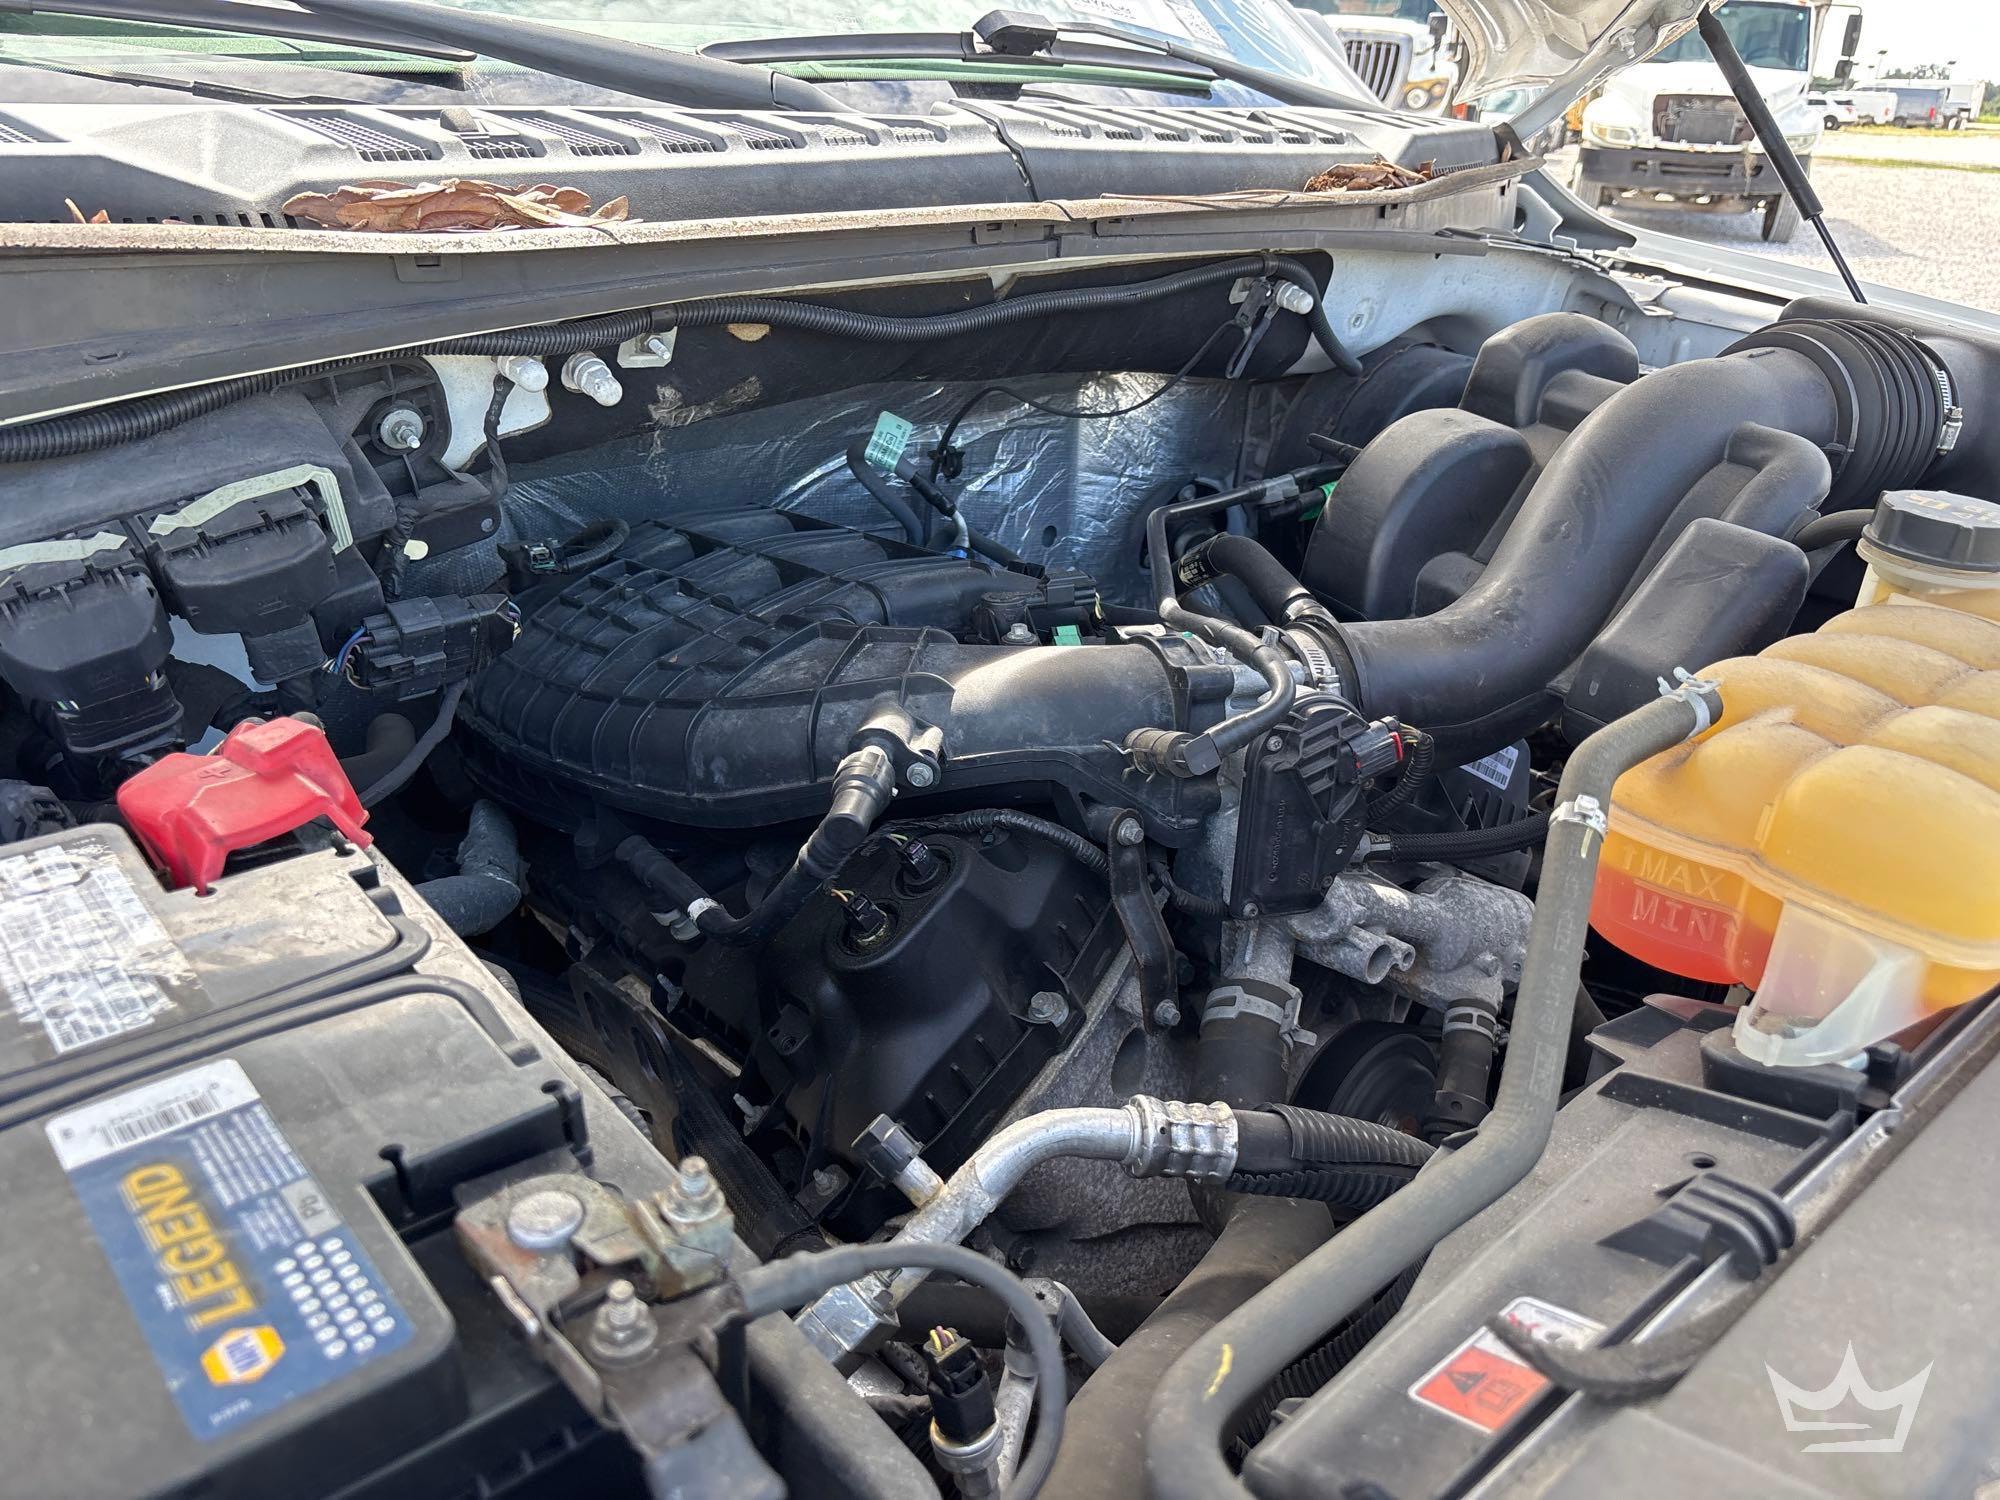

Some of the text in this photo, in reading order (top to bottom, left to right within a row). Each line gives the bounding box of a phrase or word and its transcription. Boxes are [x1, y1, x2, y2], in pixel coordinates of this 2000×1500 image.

[1640, 847, 1724, 902] MAX
[1631, 888, 1718, 941] MIN
[120, 1162, 256, 1333] LEGEND
